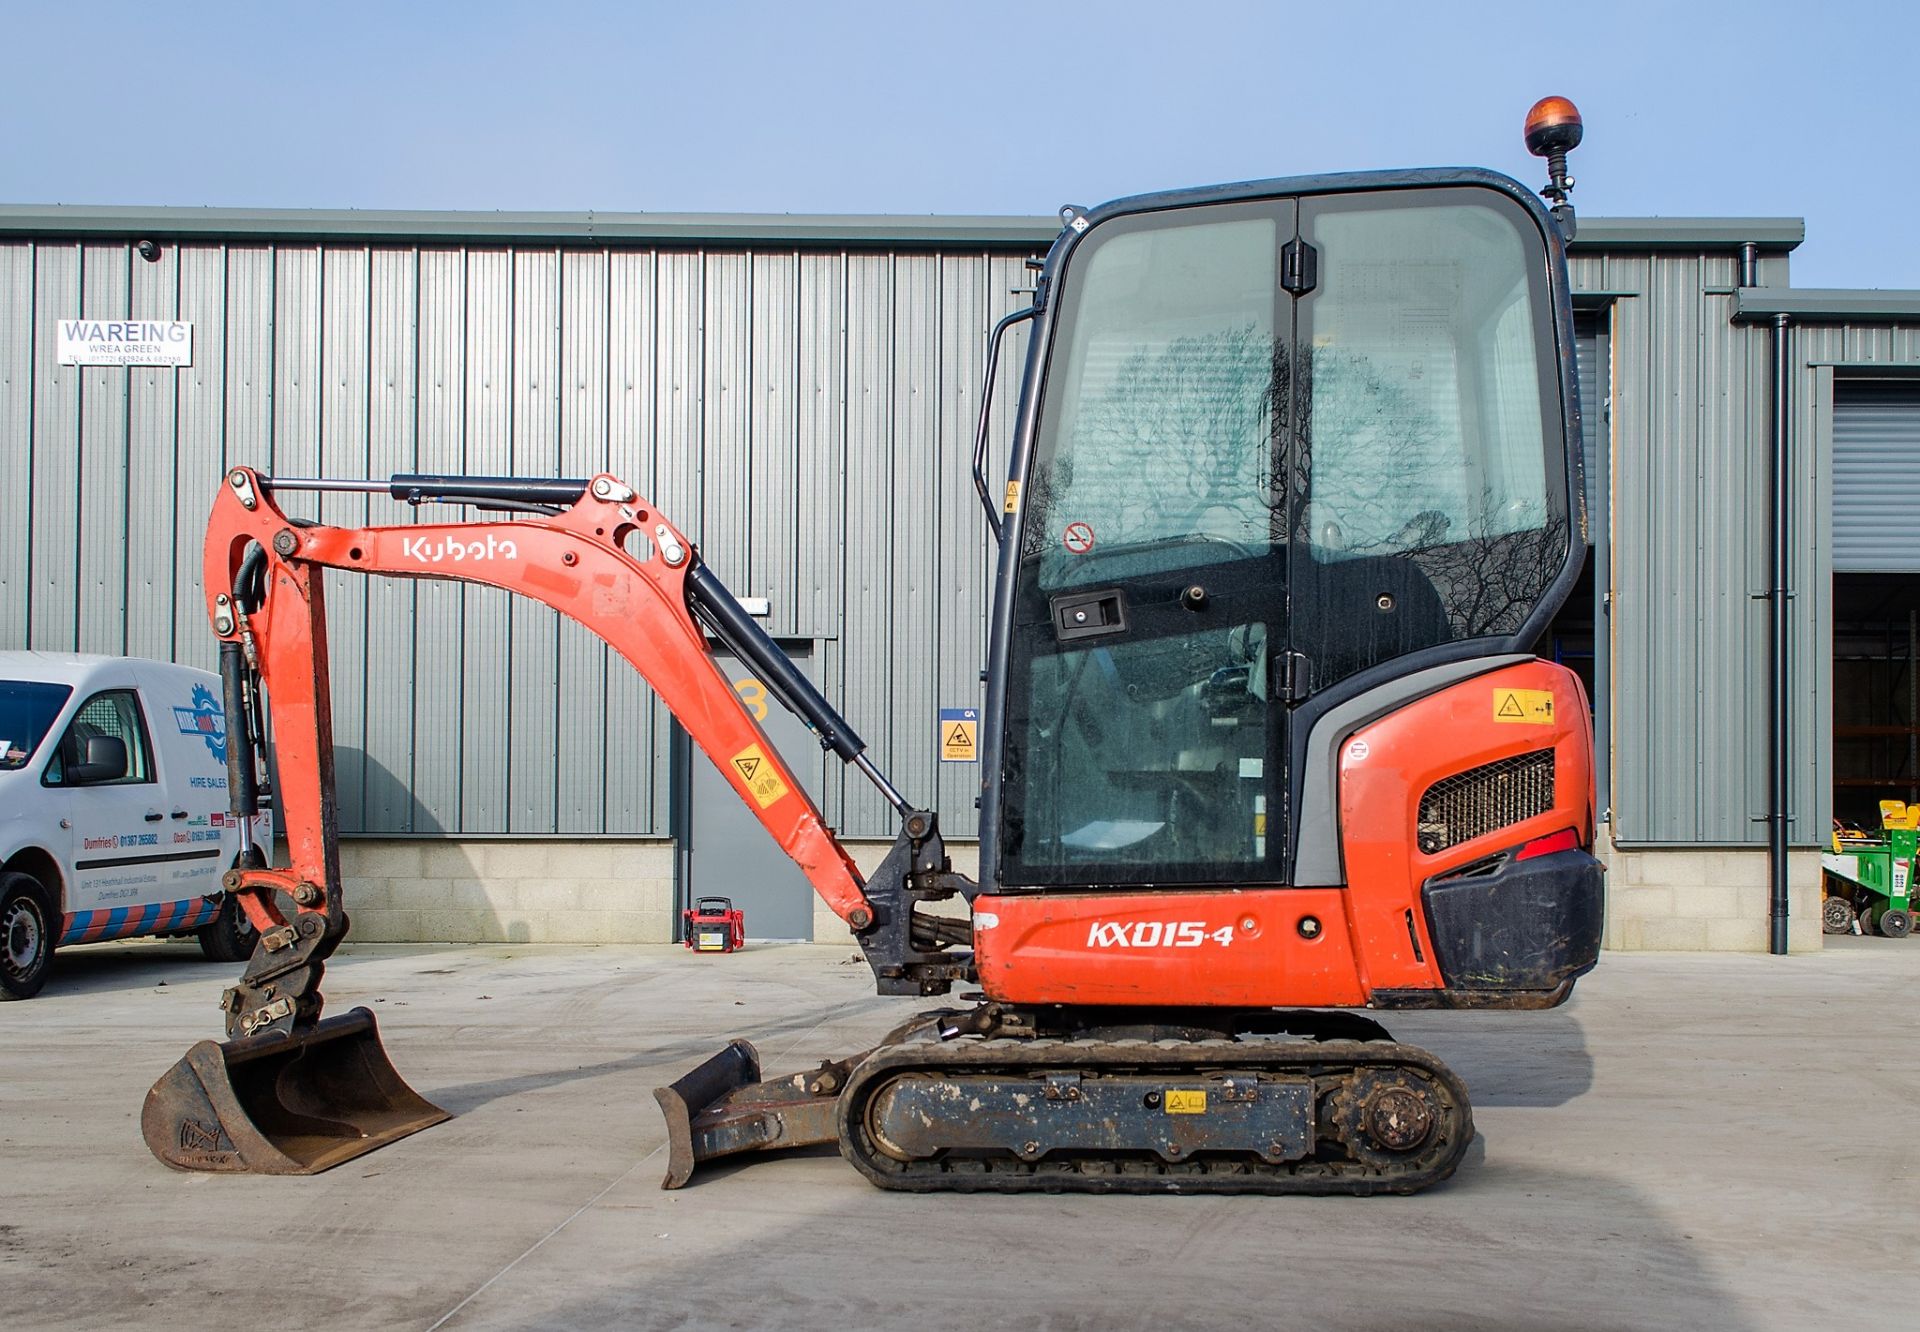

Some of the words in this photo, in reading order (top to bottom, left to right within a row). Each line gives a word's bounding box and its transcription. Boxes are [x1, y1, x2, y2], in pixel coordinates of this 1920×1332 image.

[65, 323, 185, 342] WAREING
[89, 345, 121, 353] WREA
[124, 345, 161, 353] GREEN
[403, 534, 517, 562] Kubota
[734, 678, 768, 721] 3
[190, 777, 206, 788] HIRE
[207, 777, 227, 788] SALES
[84, 837, 112, 850] Dumfries
[1086, 921, 1234, 947] KX015-4
